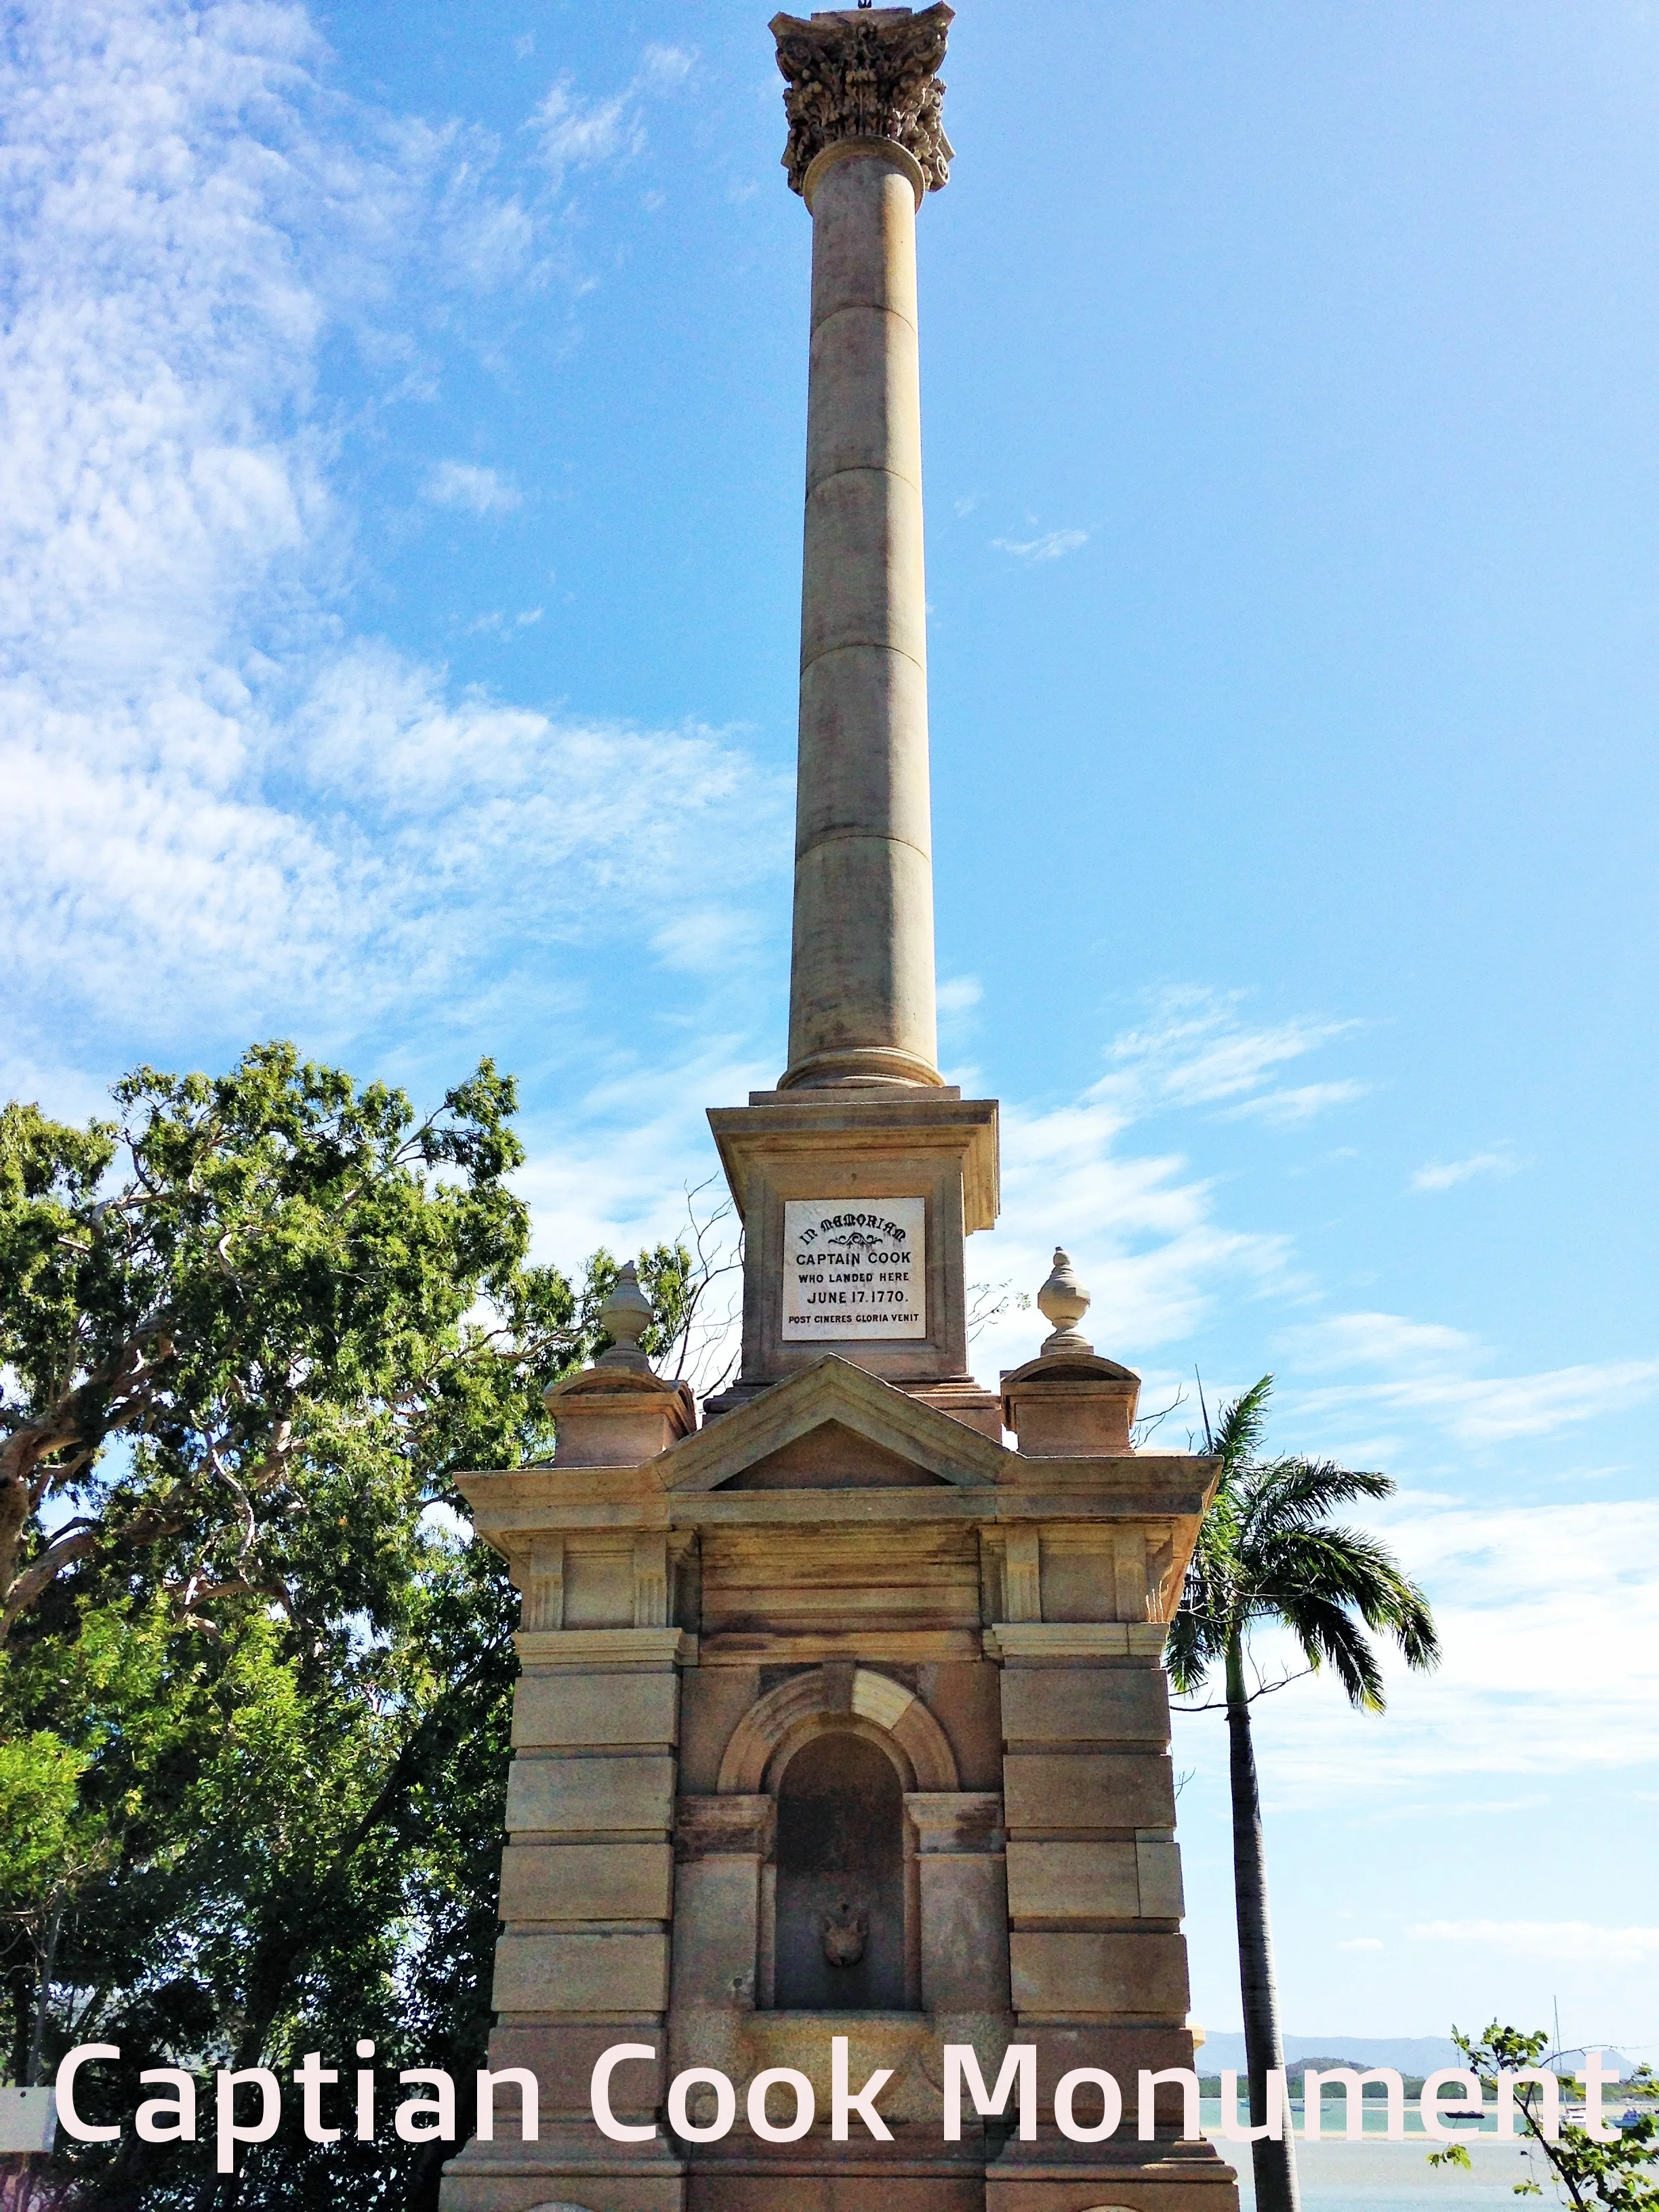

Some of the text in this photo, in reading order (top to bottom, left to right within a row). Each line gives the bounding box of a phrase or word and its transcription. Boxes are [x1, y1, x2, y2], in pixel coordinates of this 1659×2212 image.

[798, 1214, 906, 1246] IN MEMORIAM
[796, 1252, 911, 1265] CAPTAIN COOK
[798, 1272, 909, 1283] WHO LANDED HERE
[807, 1292, 846, 1303] JUNE
[789, 1313, 919, 1324] POST CINERES GLORIA VENIT
